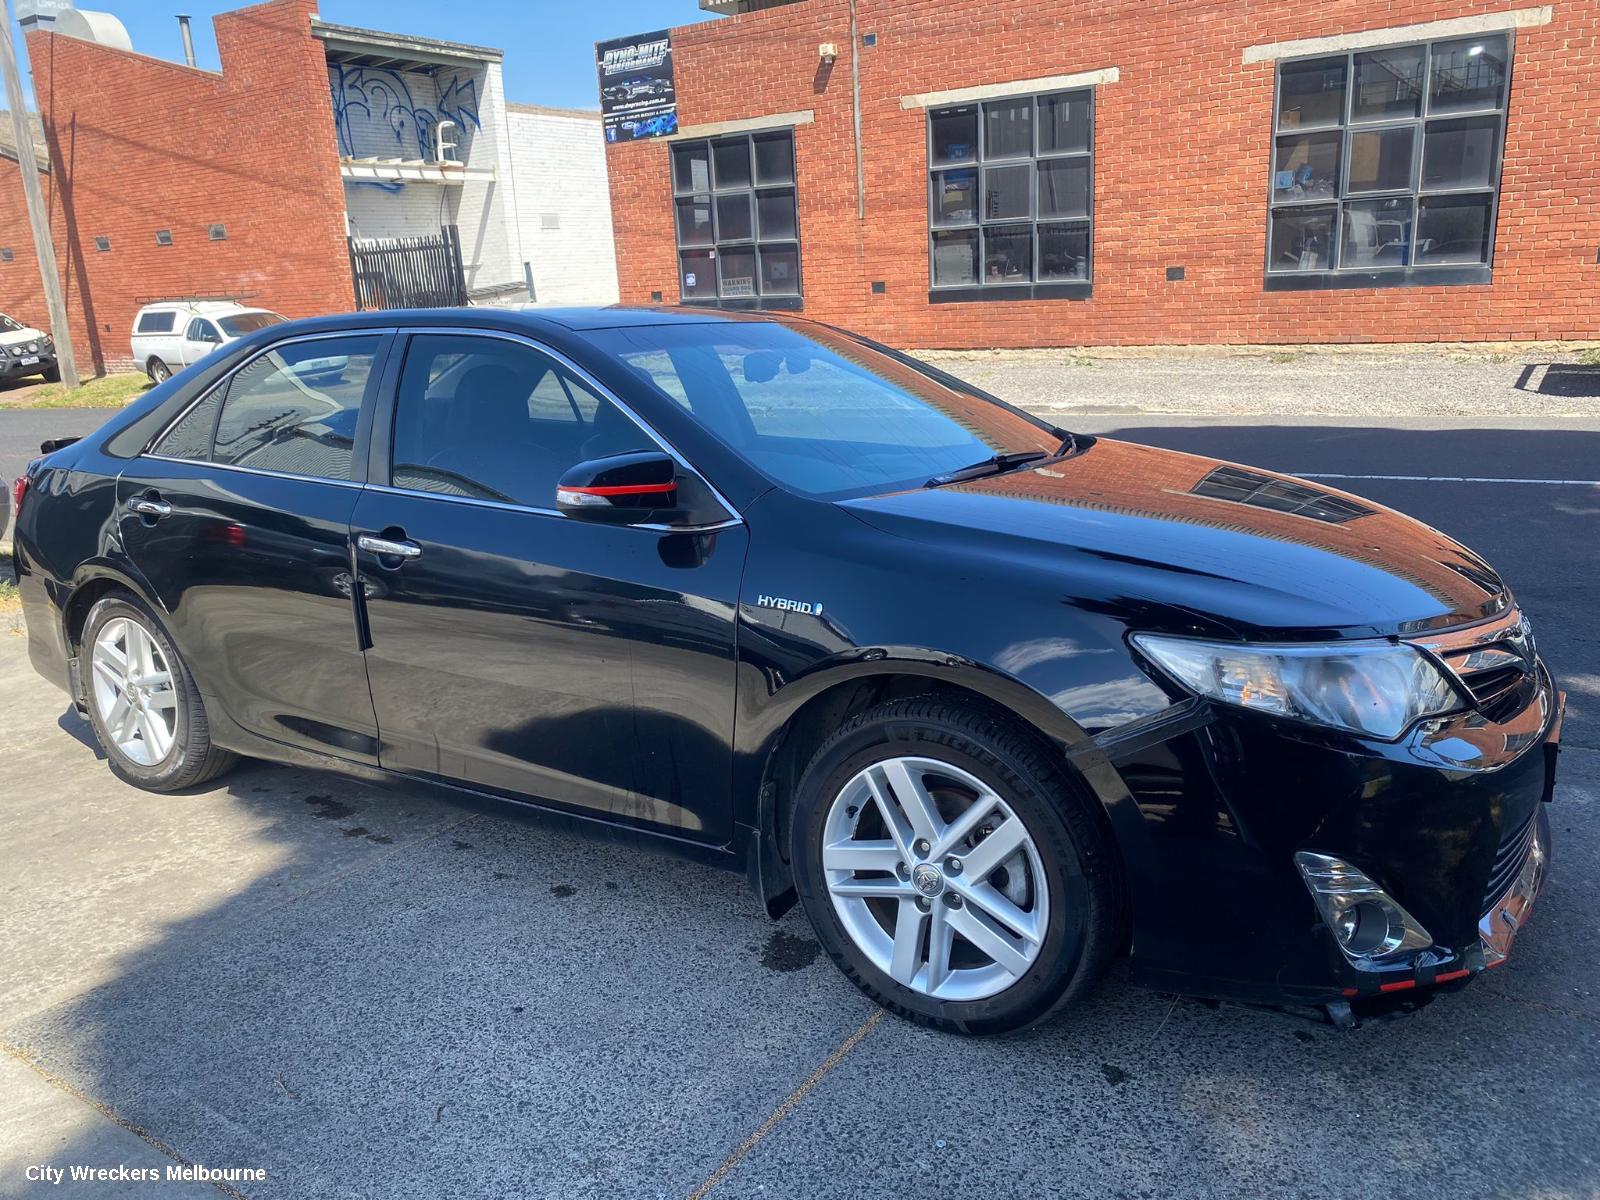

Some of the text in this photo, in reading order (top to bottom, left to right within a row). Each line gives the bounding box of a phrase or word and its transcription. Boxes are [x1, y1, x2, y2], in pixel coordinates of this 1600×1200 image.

[604, 42, 666, 65] DYNO-MITE
[607, 56, 662, 72] PERFORMANCE
[757, 594, 812, 613] HYBRID
[919, 729, 1031, 795] MICHELIN
